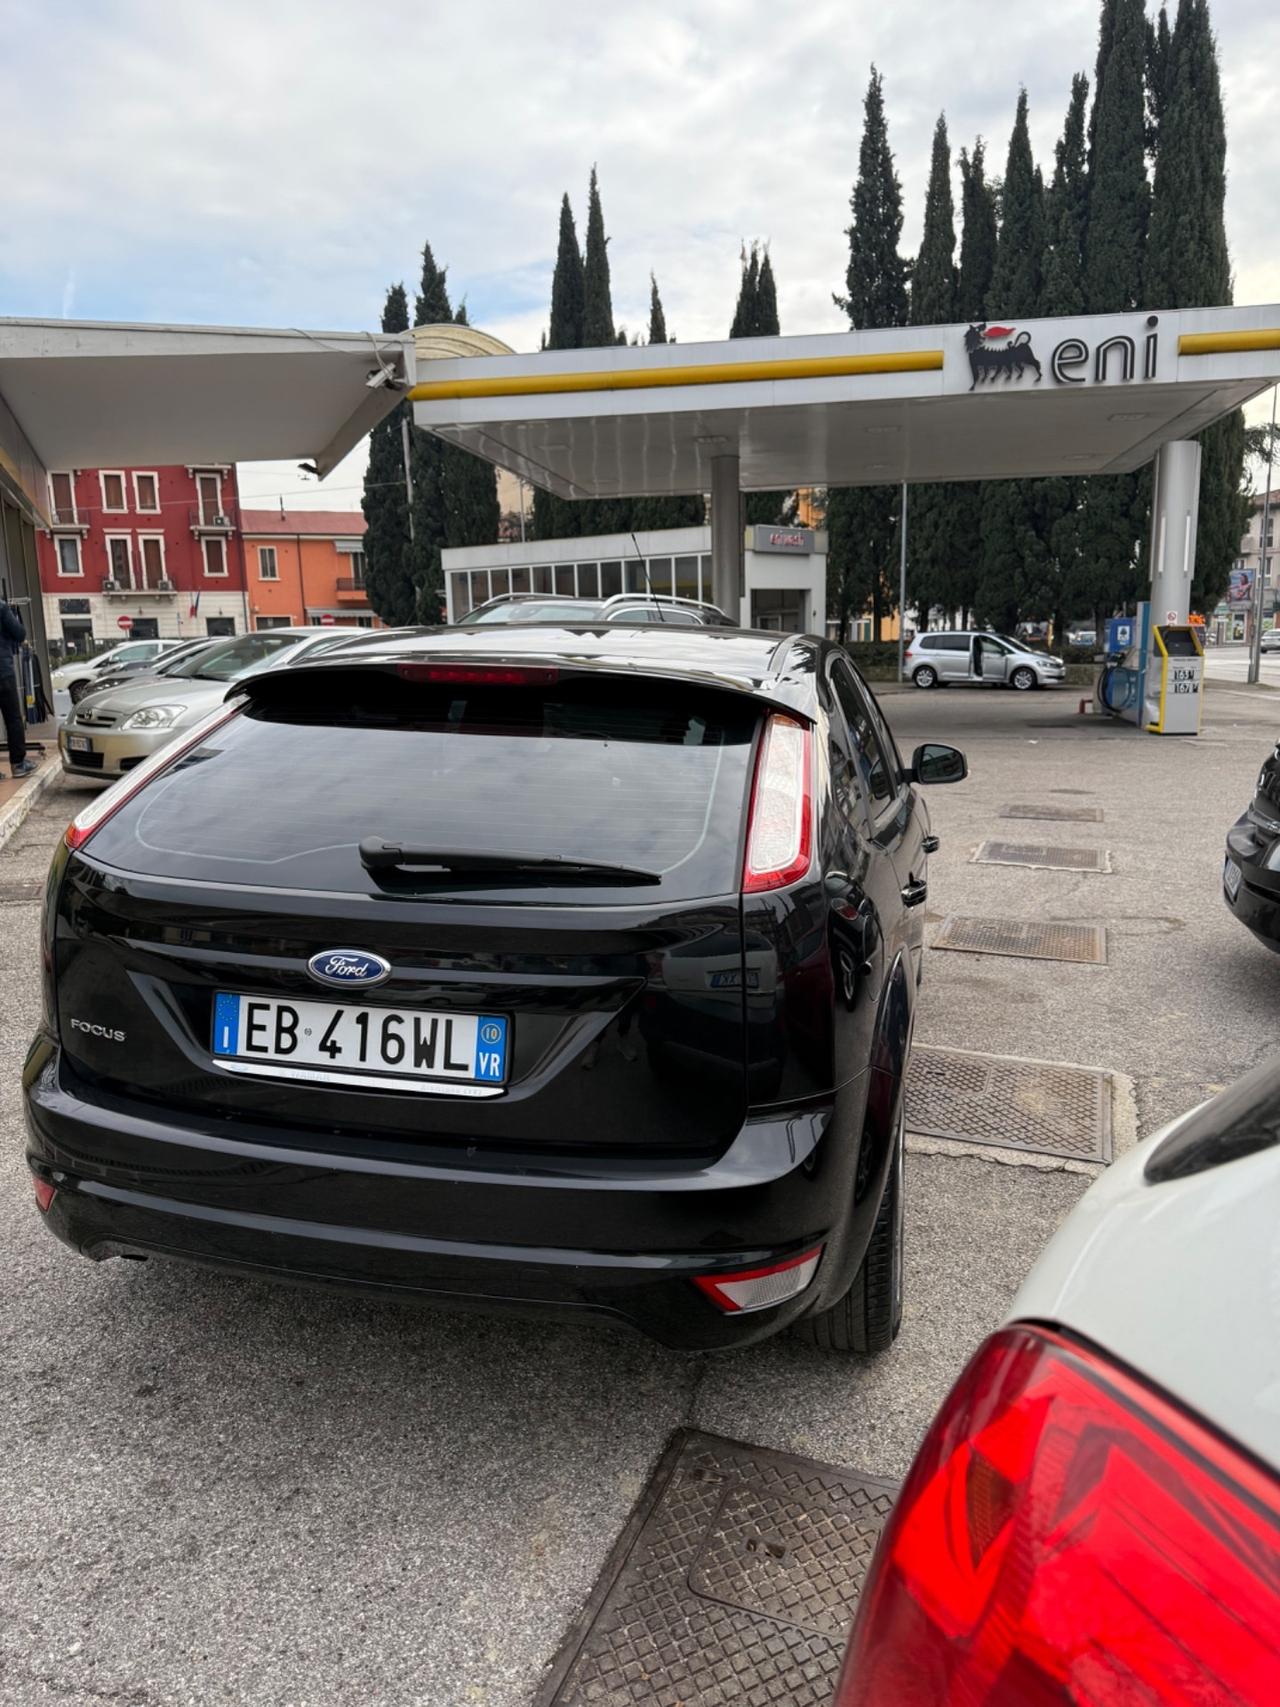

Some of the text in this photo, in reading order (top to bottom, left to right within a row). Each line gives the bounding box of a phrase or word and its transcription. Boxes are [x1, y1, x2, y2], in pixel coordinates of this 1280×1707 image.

[1051, 315, 1159, 383] eni
[324, 955, 369, 977] Ford
[70, 1018, 126, 1042] FOCUS
[246, 1002, 469, 1071] EB 416WL
[479, 1051, 500, 1076] VR
